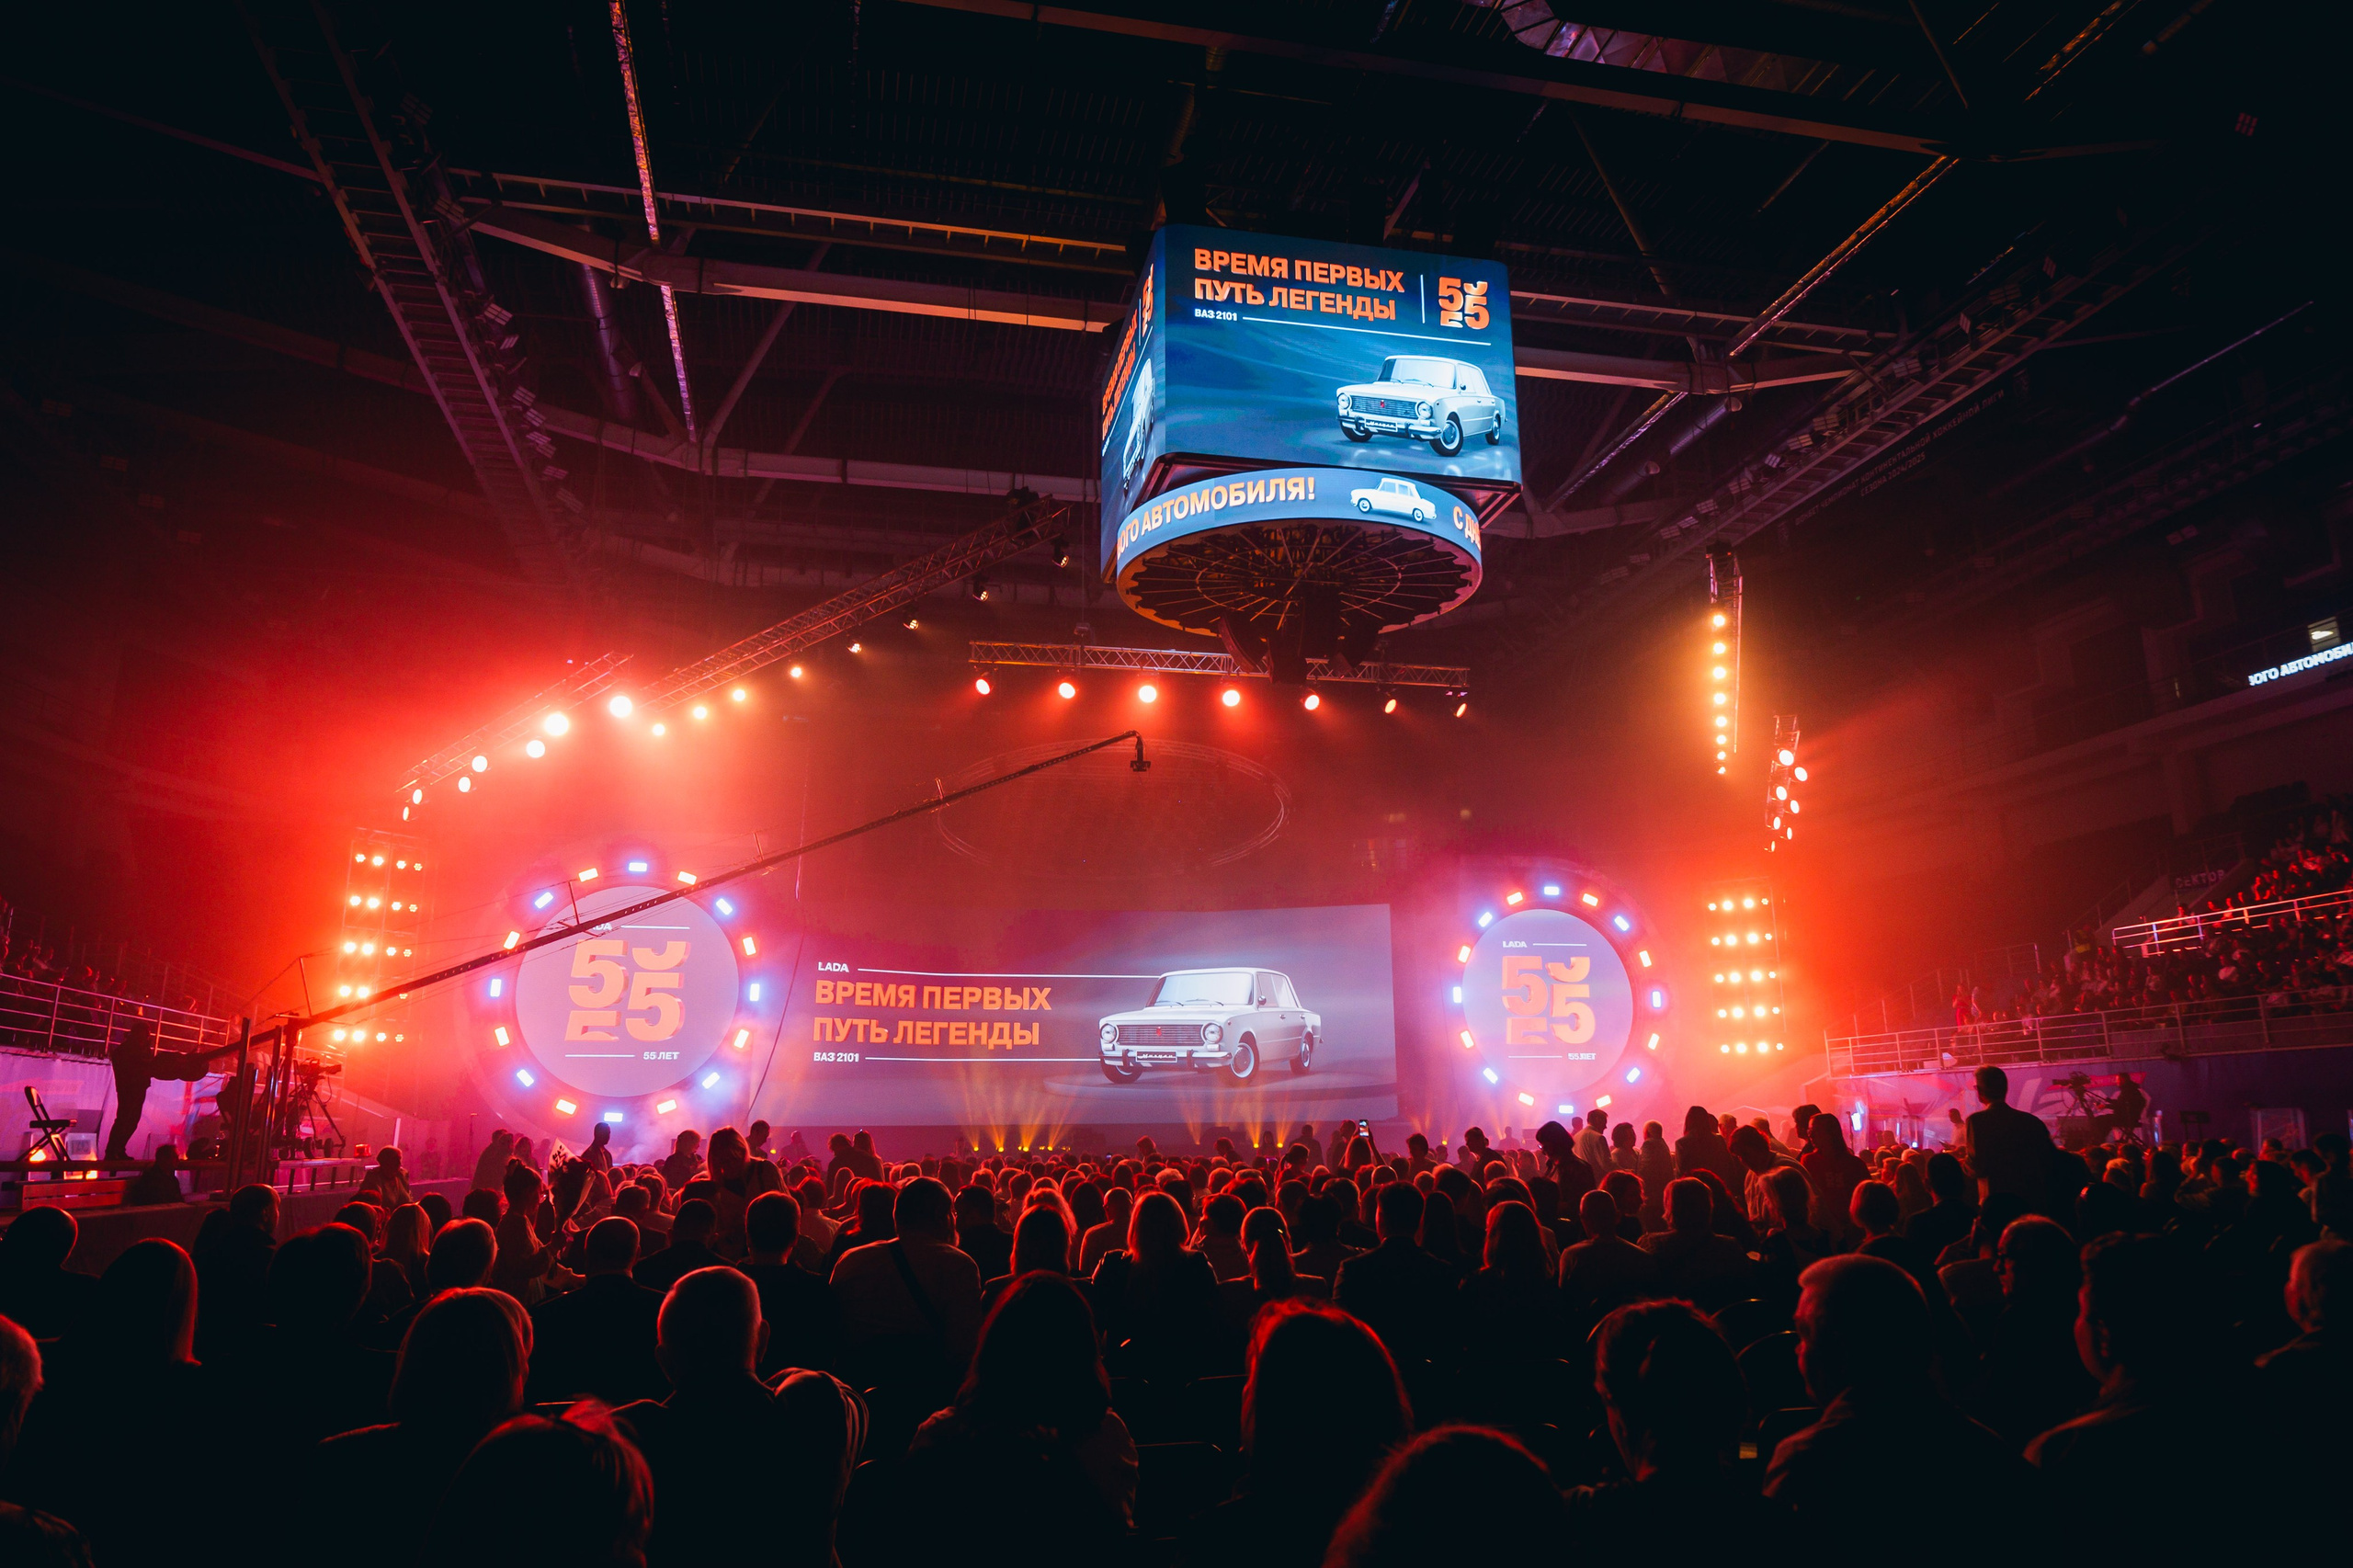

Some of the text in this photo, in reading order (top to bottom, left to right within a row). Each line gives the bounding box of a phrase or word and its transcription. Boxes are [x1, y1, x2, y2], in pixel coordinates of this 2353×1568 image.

[1195, 247, 1404, 293] ВРЕМЯ ПЕРВЫХ
[1195, 278, 1396, 322] ПУТЬ ЛЕГЕНДЫ
[1194, 308, 1238, 322] ВАЗ 2101
[1141, 476, 1315, 537] АВТОМОБИЛЯ!
[1453, 506, 1463, 530] С
[2279, 642, 2353, 676] АВТОМОБИ
[2175, 869, 2225, 889] СЕКТОР
[1502, 940, 1528, 949] LADA
[818, 961, 849, 972] LADA
[815, 980, 1051, 1010] ВРЕМЯ ПЕРВЫХ
[813, 1017, 1040, 1050] ПУТЬ ЛЕГЕНДЫ
[643, 1051, 680, 1061] 55 ЛЕТ
[813, 1051, 859, 1062] ВАЗ 2101
